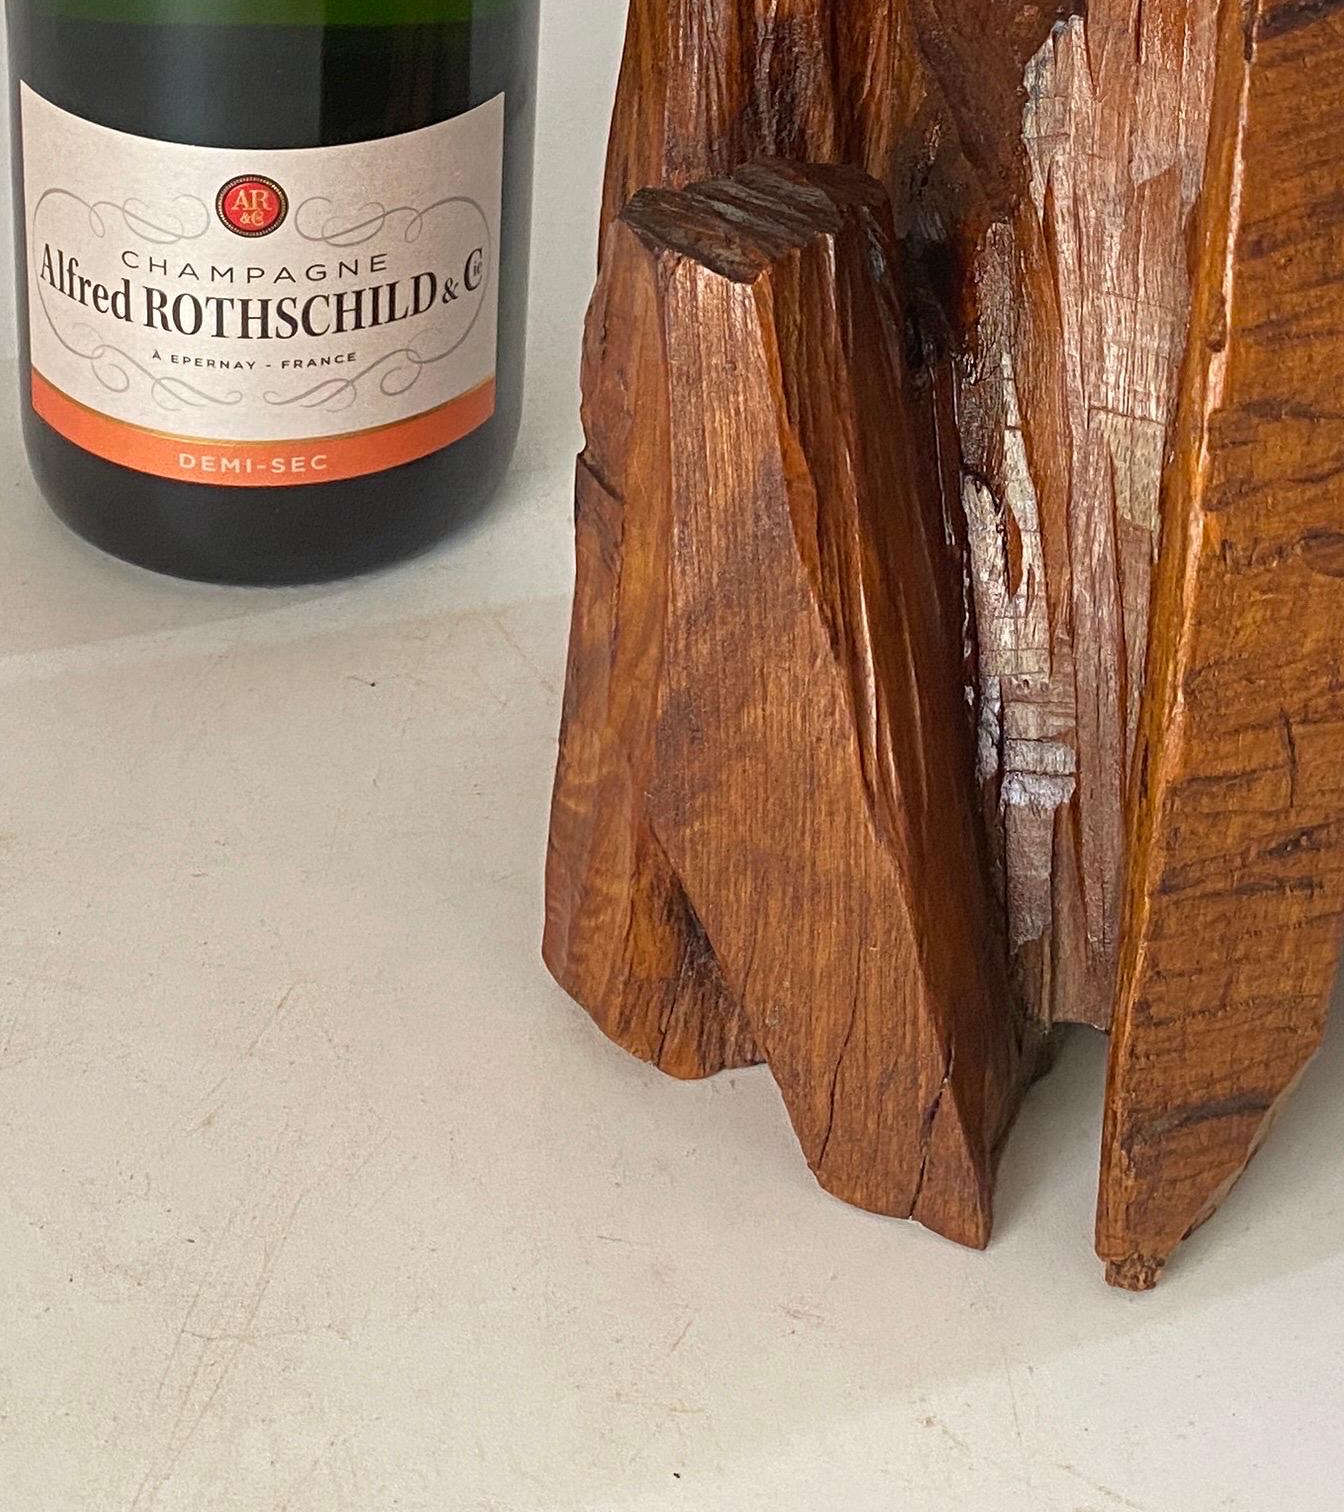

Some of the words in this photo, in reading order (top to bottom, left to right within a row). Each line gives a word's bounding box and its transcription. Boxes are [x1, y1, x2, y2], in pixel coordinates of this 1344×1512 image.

[231, 189, 273, 211] AR
[121, 250, 388, 284] CHAMPAGNE
[40, 243, 134, 323] Alfred
[142, 271, 438, 340] ROTHSCHILD
[171, 354, 256, 370] EPERNAY
[281, 352, 357, 370] FRANCE
[178, 452, 329, 474] DEMI-SEC
